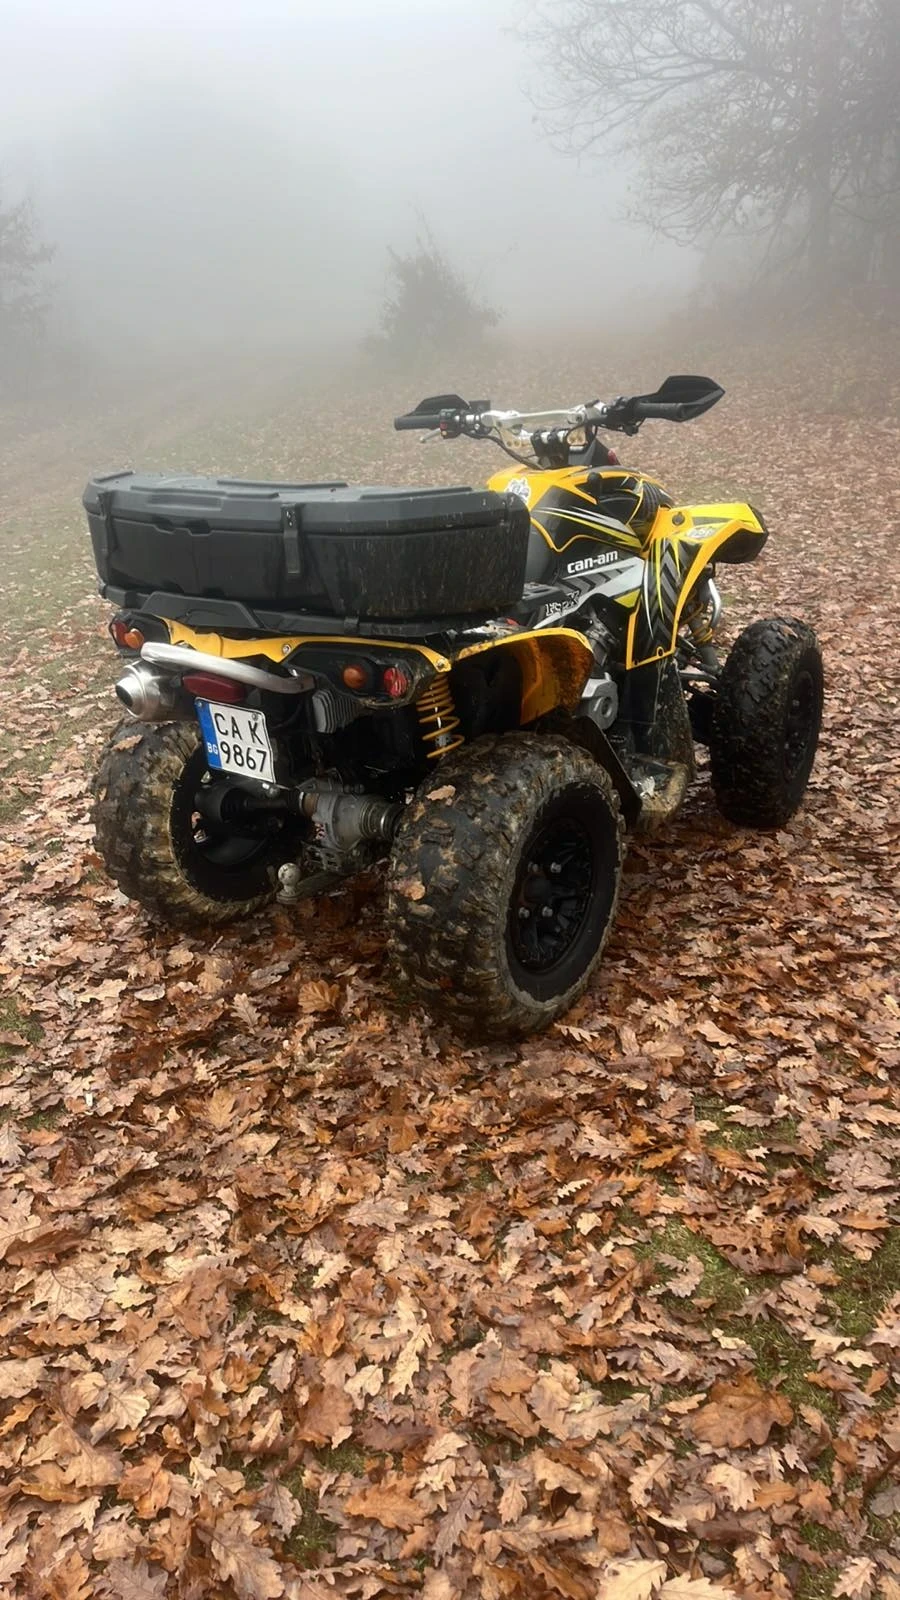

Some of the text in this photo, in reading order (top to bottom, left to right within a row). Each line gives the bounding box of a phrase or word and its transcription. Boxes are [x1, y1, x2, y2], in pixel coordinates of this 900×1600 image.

[567, 550, 618, 574] can-am
[214, 712, 264, 745] CA K
[206, 742, 218, 755] BG
[220, 741, 267, 773] 9867
